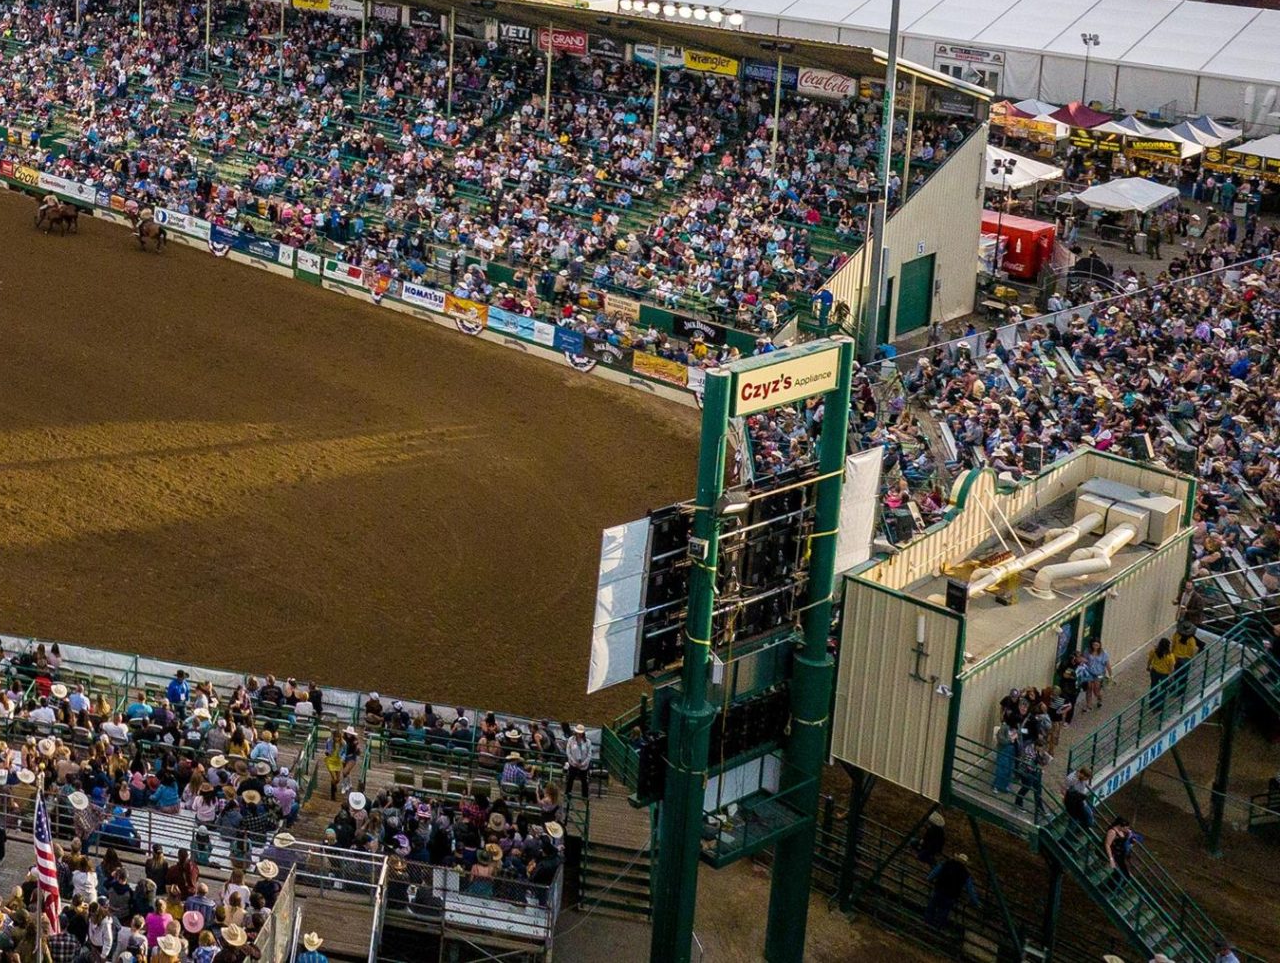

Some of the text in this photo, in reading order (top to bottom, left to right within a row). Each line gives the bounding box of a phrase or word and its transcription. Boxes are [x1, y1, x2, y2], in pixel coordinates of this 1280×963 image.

[500, 23, 530, 38] YETI
[551, 33, 585, 46] GRAND
[689, 52, 731, 70] Wrangler
[799, 69, 851, 94] Coca-Cola
[404, 285, 444, 304] KOMATSU
[740, 370, 832, 401] Czyz's Appliance
